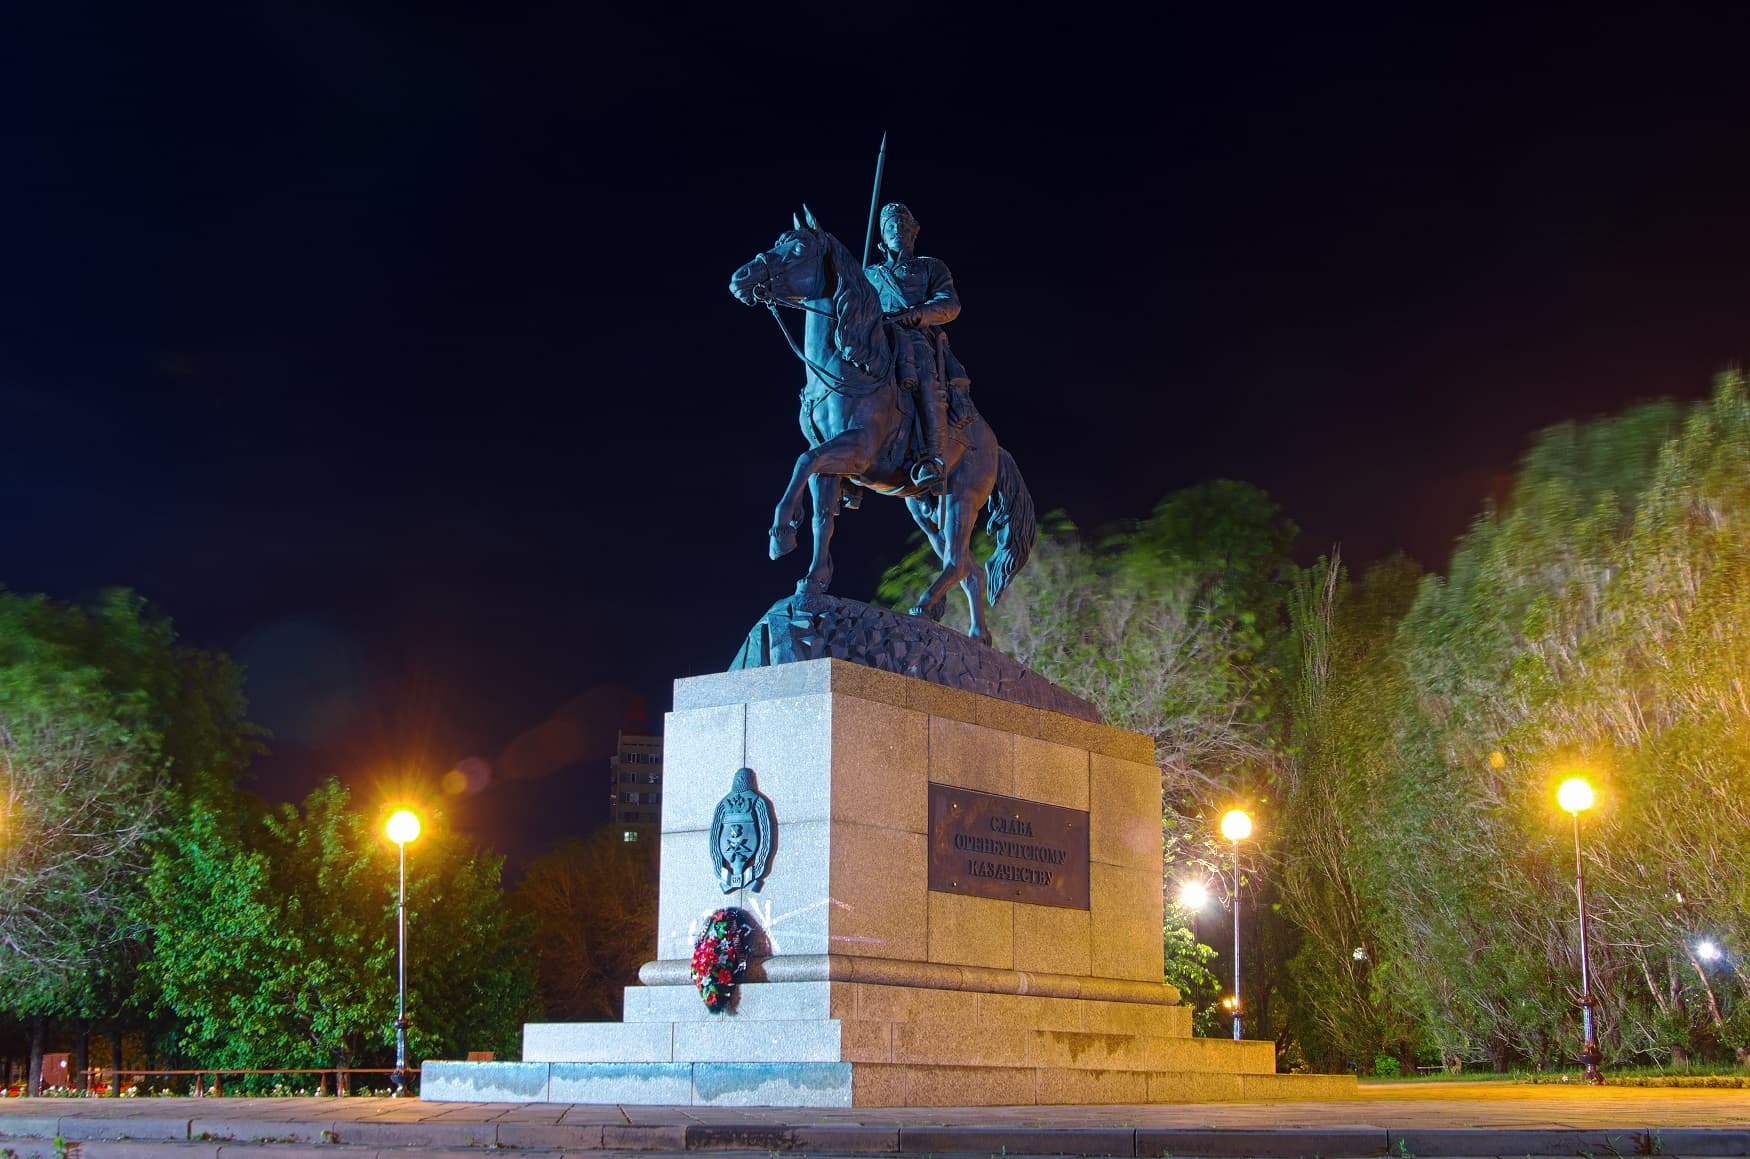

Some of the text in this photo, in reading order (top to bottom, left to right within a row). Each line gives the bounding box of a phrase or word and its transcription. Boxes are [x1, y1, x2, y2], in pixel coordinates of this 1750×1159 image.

[990, 816, 1033, 837] СЛАВА
[954, 834, 1067, 865] ОРЕНБУРГСКОМУ
[968, 860, 1053, 886] КАЗАЧЕСТВУ
